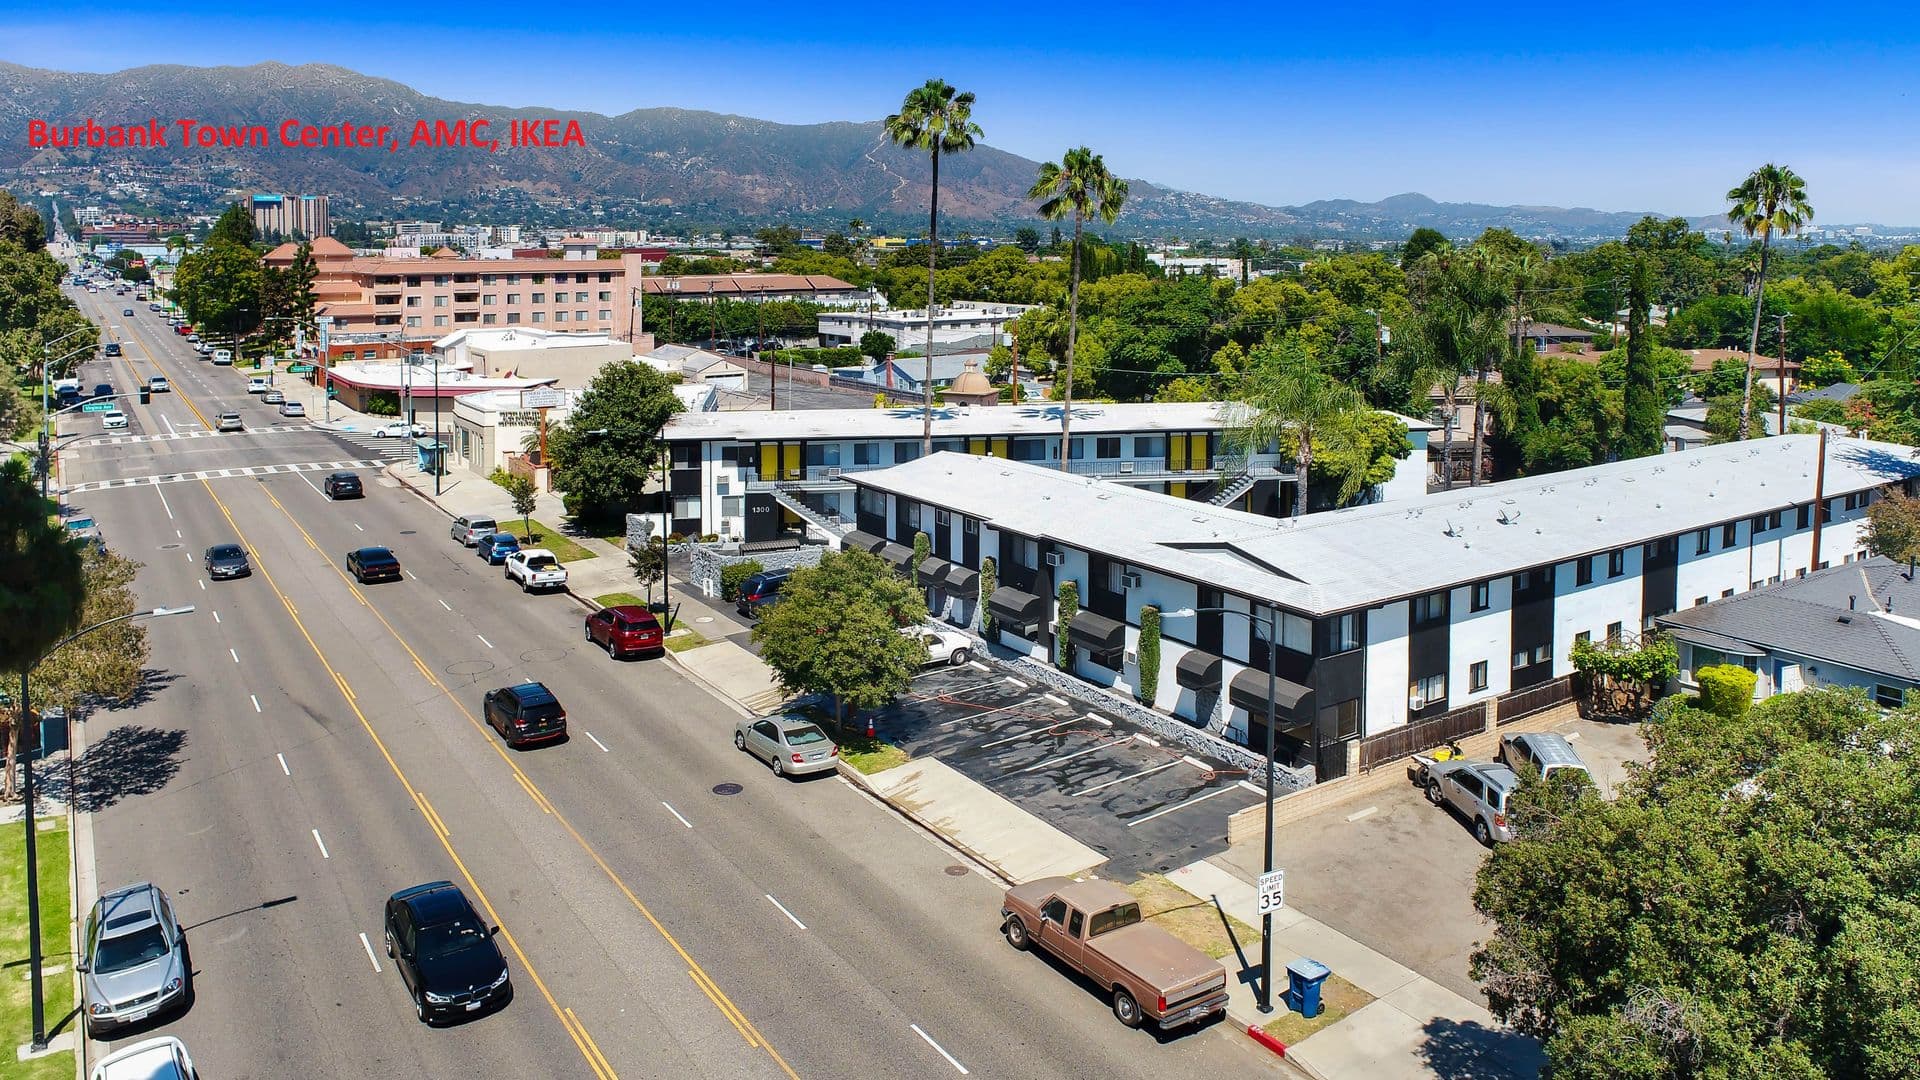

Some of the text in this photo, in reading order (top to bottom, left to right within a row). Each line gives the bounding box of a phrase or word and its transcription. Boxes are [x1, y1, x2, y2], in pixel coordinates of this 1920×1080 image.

[1260, 874, 1282, 886] SPEED
[1262, 883, 1280, 894] LIMIT
[1261, 891, 1282, 910] 35
